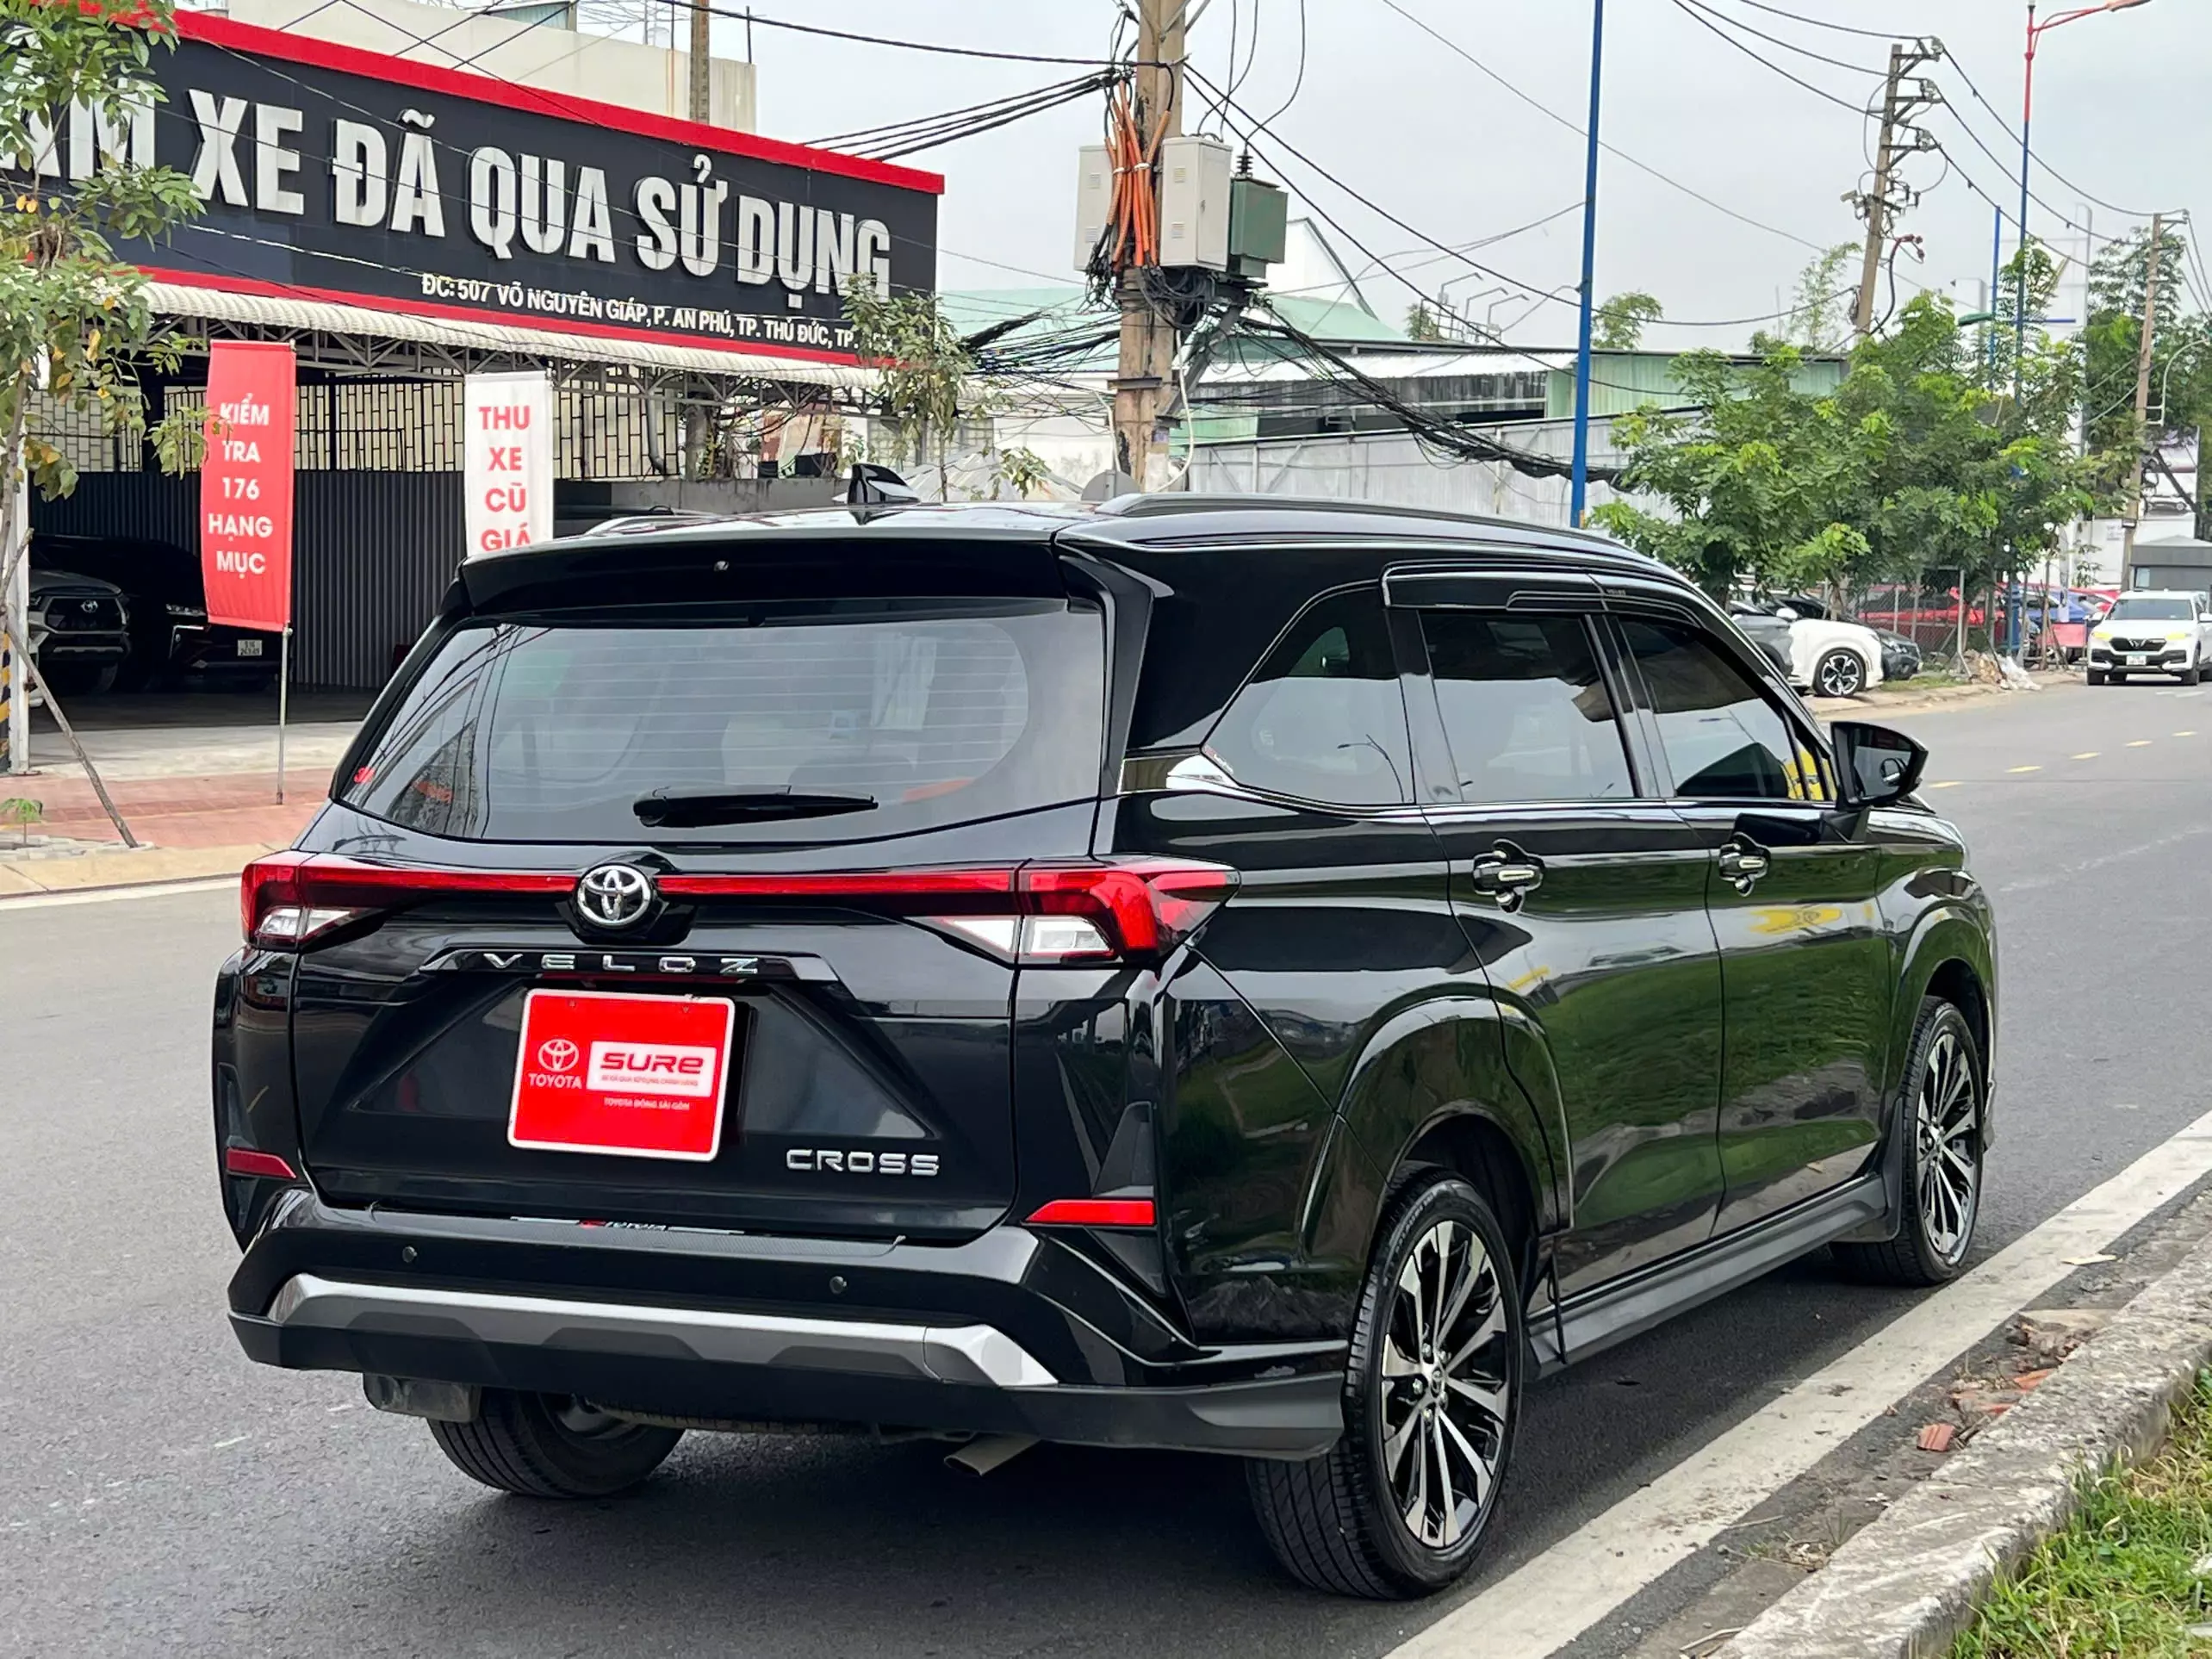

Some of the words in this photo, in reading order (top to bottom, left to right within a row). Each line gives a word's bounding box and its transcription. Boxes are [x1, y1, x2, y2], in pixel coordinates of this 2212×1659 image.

[189, 89, 304, 214] XE
[332, 109, 445, 237] ĐÃ
[469, 146, 616, 262] QUA
[637, 154, 728, 276] SỬ
[737, 195, 890, 309] DỤNG
[422, 273, 455, 296] ĐC:
[457, 278, 492, 301] 507
[497, 281, 524, 307] VÕ
[528, 289, 602, 318] NGUYÊN
[606, 297, 651, 327] GIÁP,
[654, 306, 669, 326] P.
[673, 308, 697, 329] AN
[699, 309, 735, 338] PHÚ,
[736, 316, 761, 338] TP.
[764, 317, 793, 341] THỦ
[798, 320, 833, 349] ĐỨC,
[835, 328, 859, 349] TP.
[219, 393, 270, 426] KIỂM
[479, 406, 531, 430] THU
[221, 440, 261, 463] TRA
[488, 447, 522, 471] XE
[221, 476, 260, 500] 176
[485, 482, 526, 513] CŨ
[208, 513, 273, 542] HẠNG
[481, 522, 531, 551] GIÁ
[216, 550, 265, 579] MỤC
[483, 953, 759, 975] VELOZ
[528, 1072, 582, 1090] TOYOTA
[786, 1149, 940, 1176] CROSS
